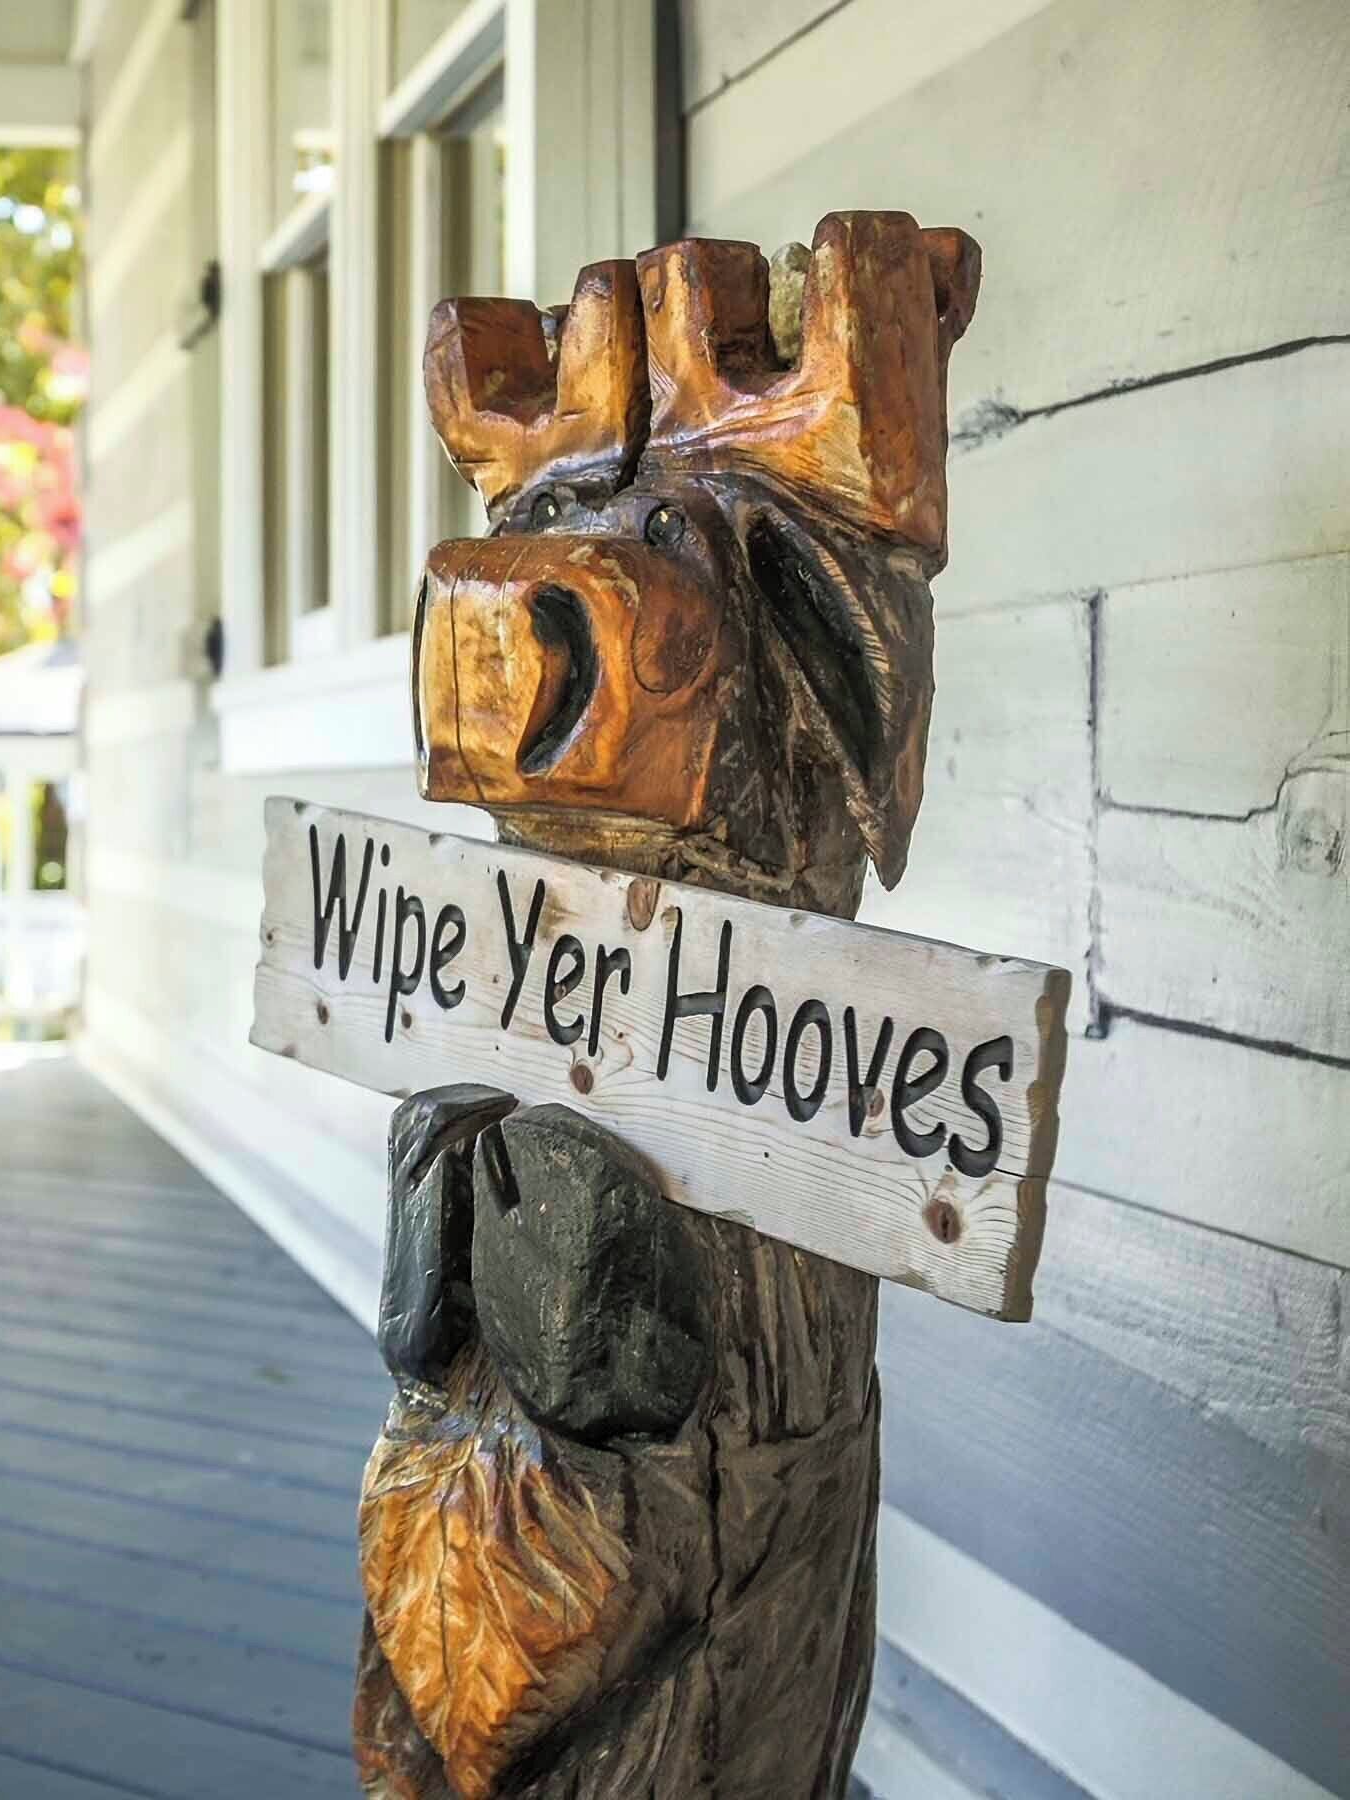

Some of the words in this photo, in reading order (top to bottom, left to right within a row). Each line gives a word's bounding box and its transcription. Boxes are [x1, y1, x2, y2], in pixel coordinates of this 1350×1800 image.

[308, 824, 467, 1044] Wipe
[496, 869, 631, 1057] Yer
[655, 906, 1015, 1178] Hooves
